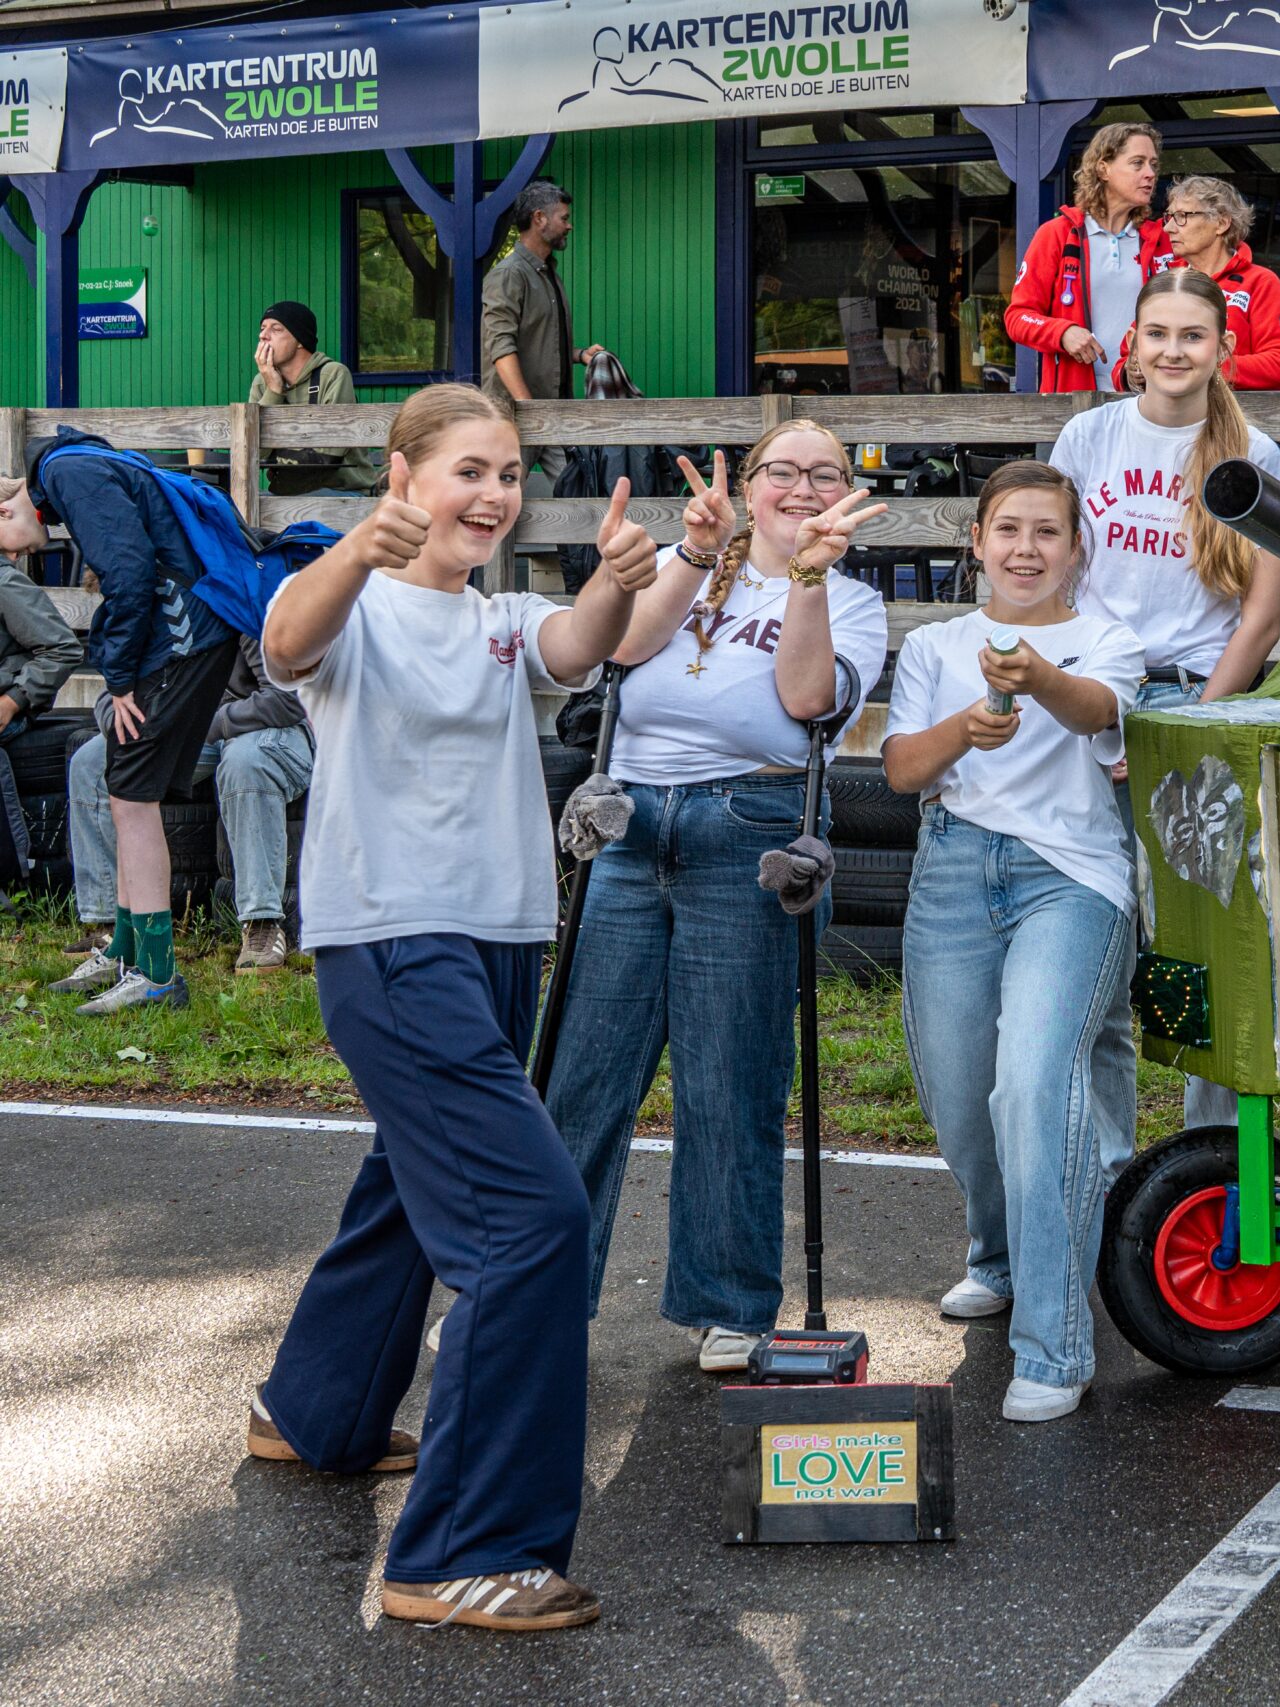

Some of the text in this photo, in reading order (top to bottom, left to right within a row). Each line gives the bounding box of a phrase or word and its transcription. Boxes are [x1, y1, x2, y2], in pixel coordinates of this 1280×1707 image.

[628, 0, 909, 53] KARTCENTRUM
[146, 47, 378, 94] KARTCENTRUM
[722, 35, 910, 82] ZWOLLE
[224, 80, 379, 121] ZWOLLE
[723, 74, 910, 102] KARTEN DOE JE BUITEN
[225, 115, 379, 139] KARTEN DOE JE BUITEN
[888, 264, 930, 281] WORLD
[877, 280, 939, 298] CHAMPION
[896, 297, 921, 312] 2021
[86, 315, 136, 324] KARTCENTRUM
[1087, 481, 1118, 518] LE
[1107, 522, 1188, 558] PARIS
[771, 1432, 903, 1449] Girls make
[771, 1449, 906, 1487] LOVE
[795, 1485, 888, 1499] not war
